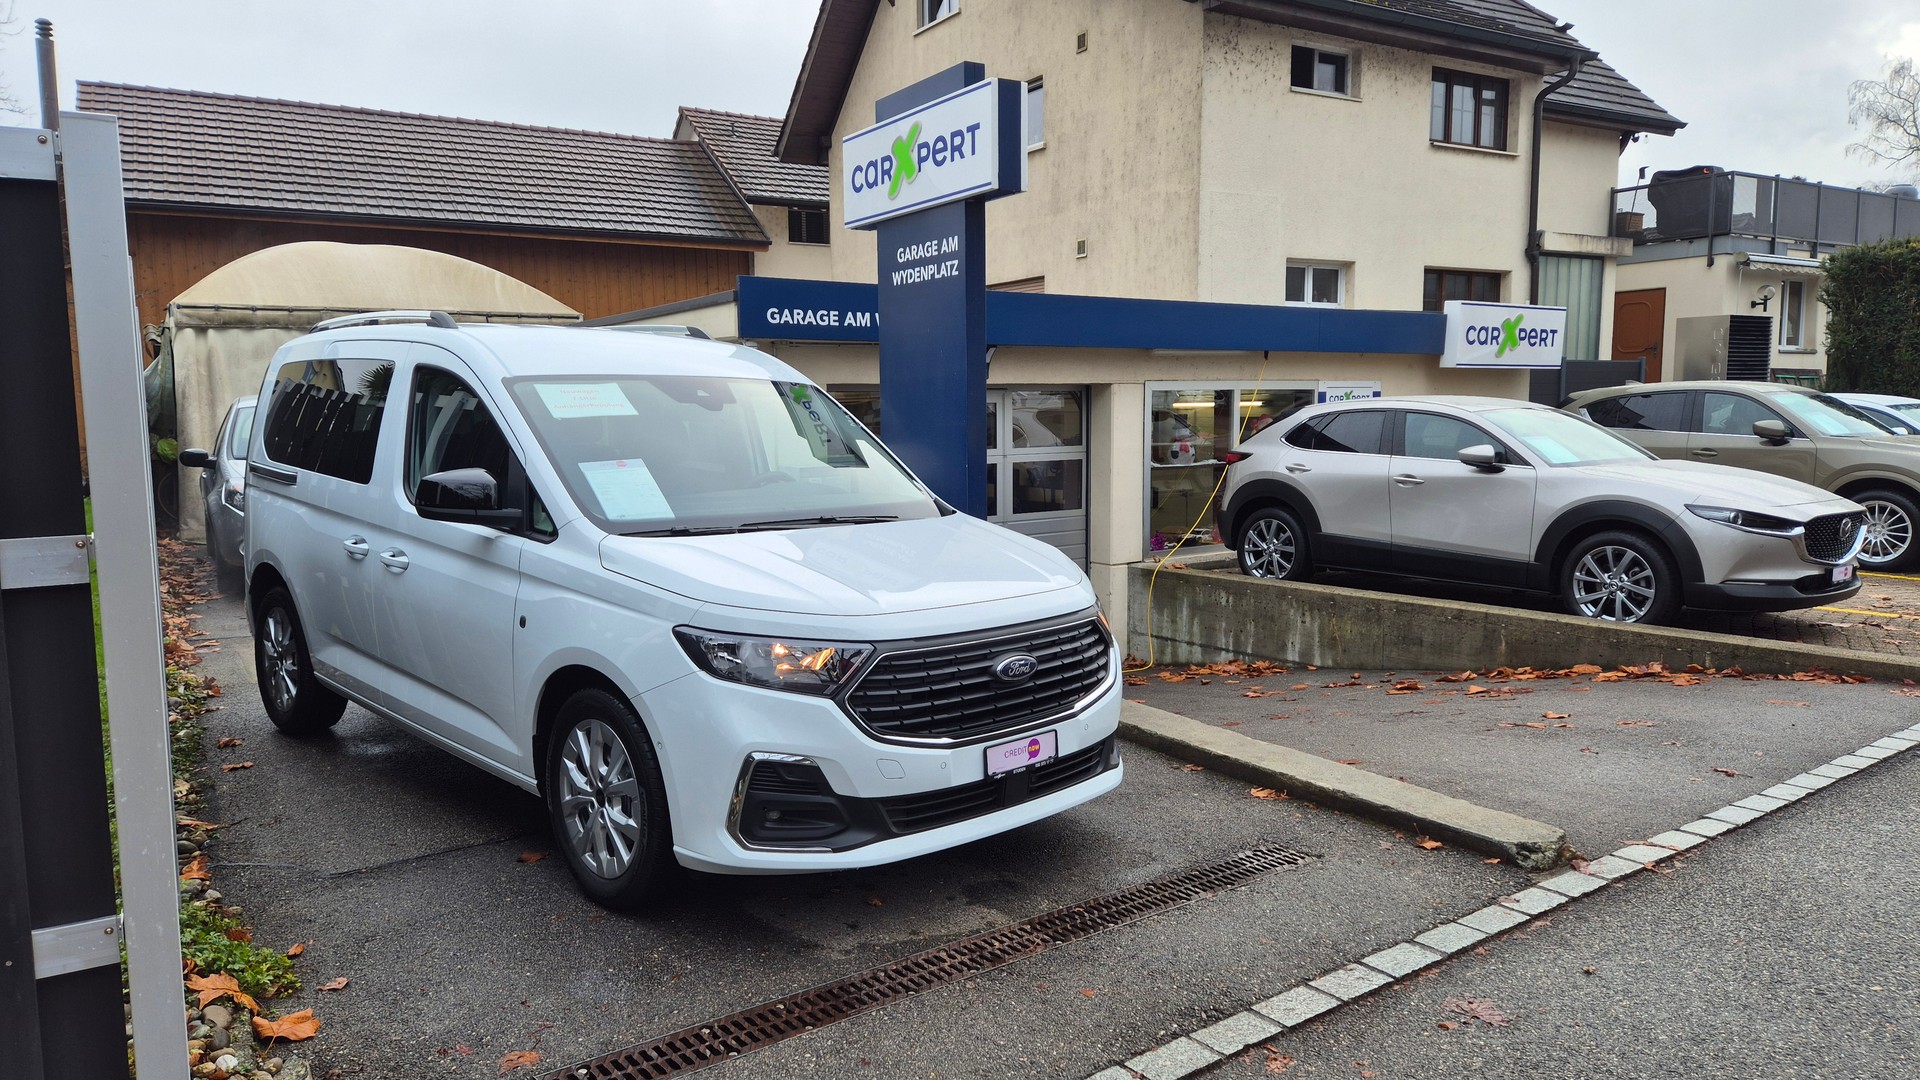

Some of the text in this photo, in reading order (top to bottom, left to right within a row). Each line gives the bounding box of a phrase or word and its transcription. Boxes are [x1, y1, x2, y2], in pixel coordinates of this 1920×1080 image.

[897, 235, 959, 263] GARAGE AM
[892, 259, 959, 287] WYDENPLATZ
[766, 307, 839, 326] GARAGE
[844, 311, 871, 327] AM
[1008, 660, 1031, 676] Ford
[1004, 745, 1027, 759] CREDIT
